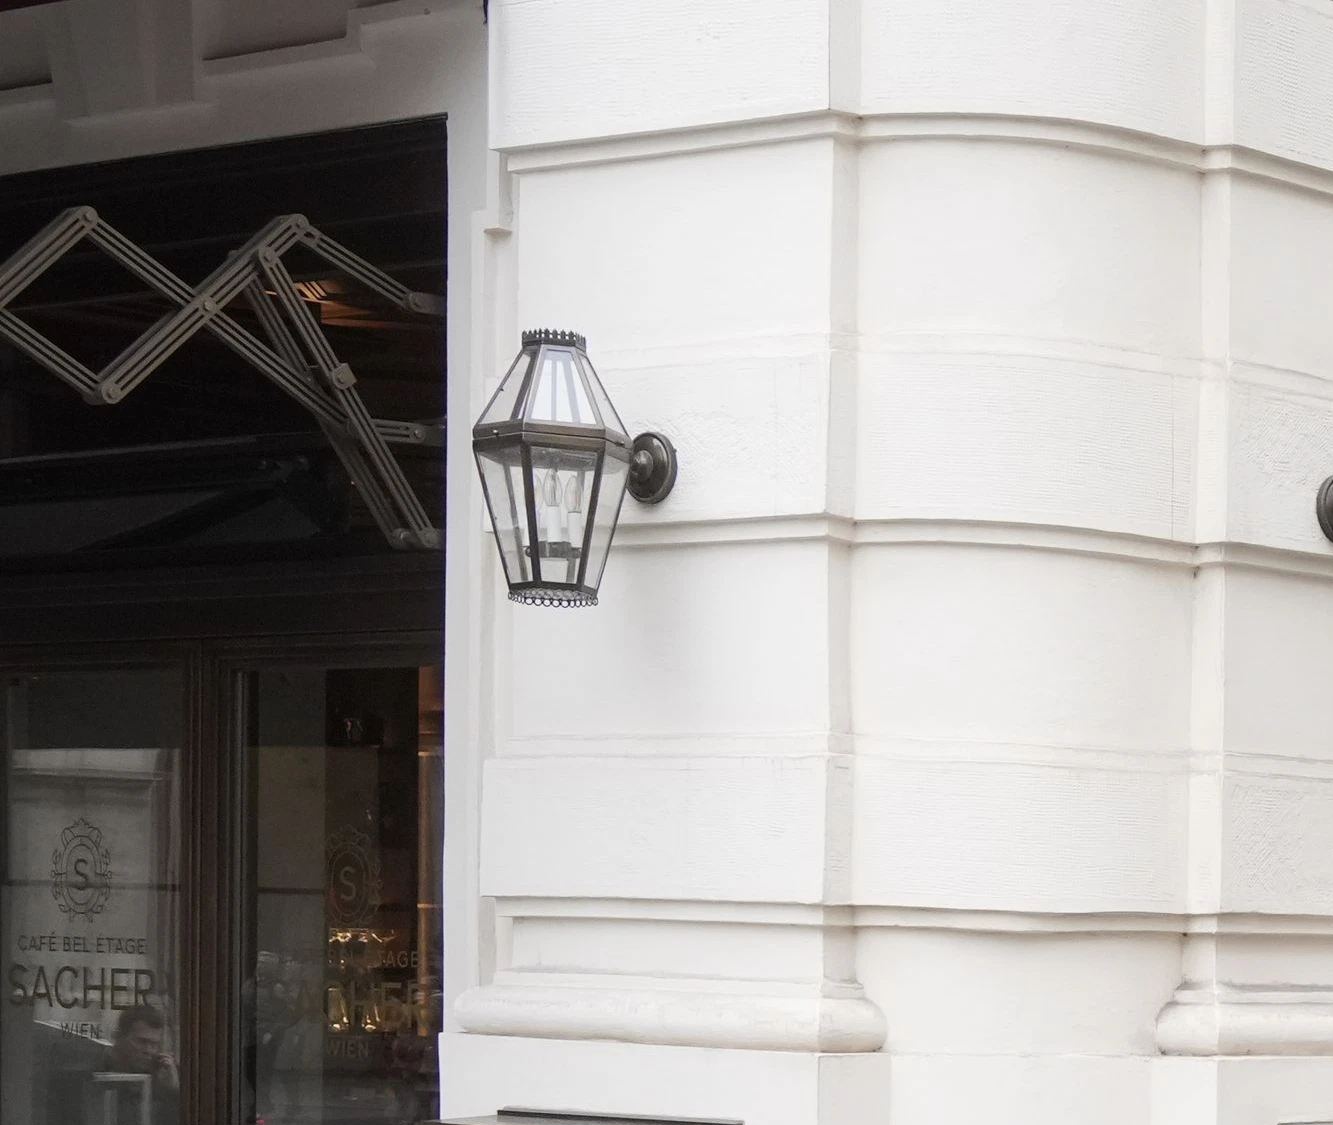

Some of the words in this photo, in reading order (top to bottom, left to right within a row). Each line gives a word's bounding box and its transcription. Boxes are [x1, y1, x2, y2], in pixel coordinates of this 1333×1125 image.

[17, 931, 58, 952] CAFÉ
[62, 936, 90, 953] BEL
[8, 963, 156, 1011] SACHER
[60, 1022, 104, 1039] WIEN
